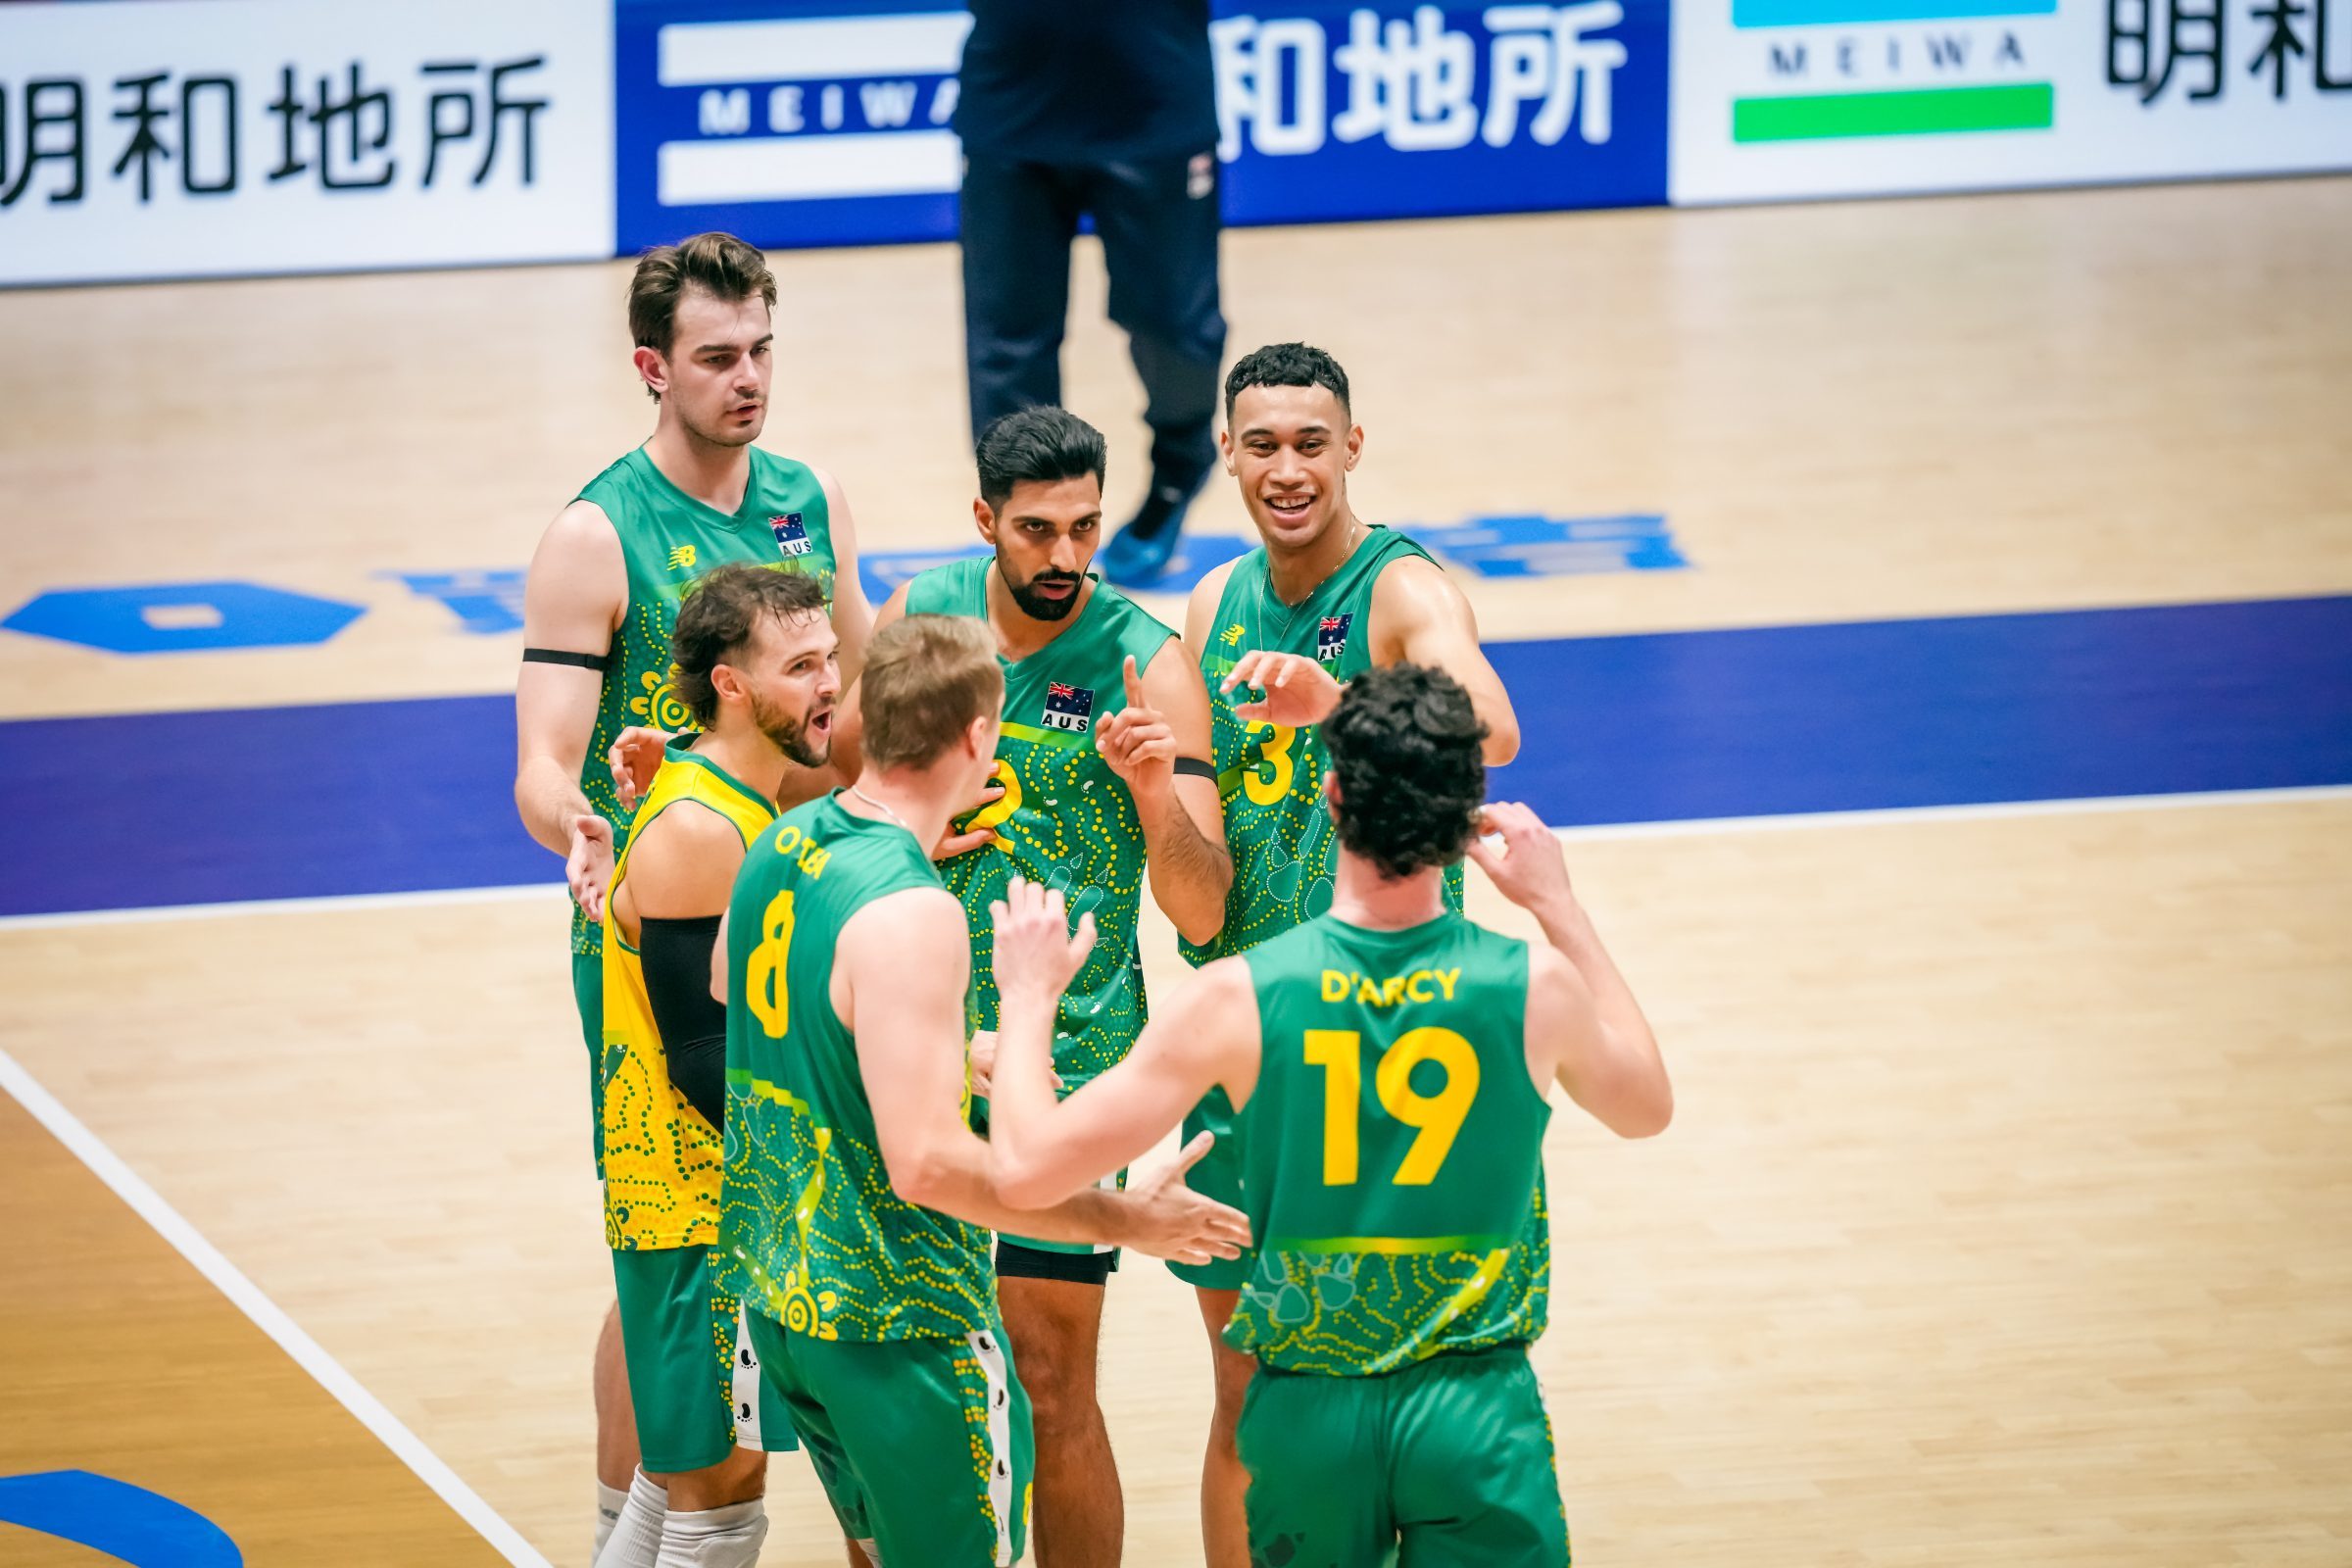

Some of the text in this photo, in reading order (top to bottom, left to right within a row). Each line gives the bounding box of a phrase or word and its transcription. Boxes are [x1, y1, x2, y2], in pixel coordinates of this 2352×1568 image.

[1769, 30, 2027, 77] MEIWA
[782, 541, 811, 557] AUS
[1042, 713, 1088, 732] AUS
[1243, 719, 1297, 806] 3
[746, 889, 796, 1039] 8
[1321, 967, 1461, 1007] D'ARCY
[1303, 1026, 1481, 1186] 19
